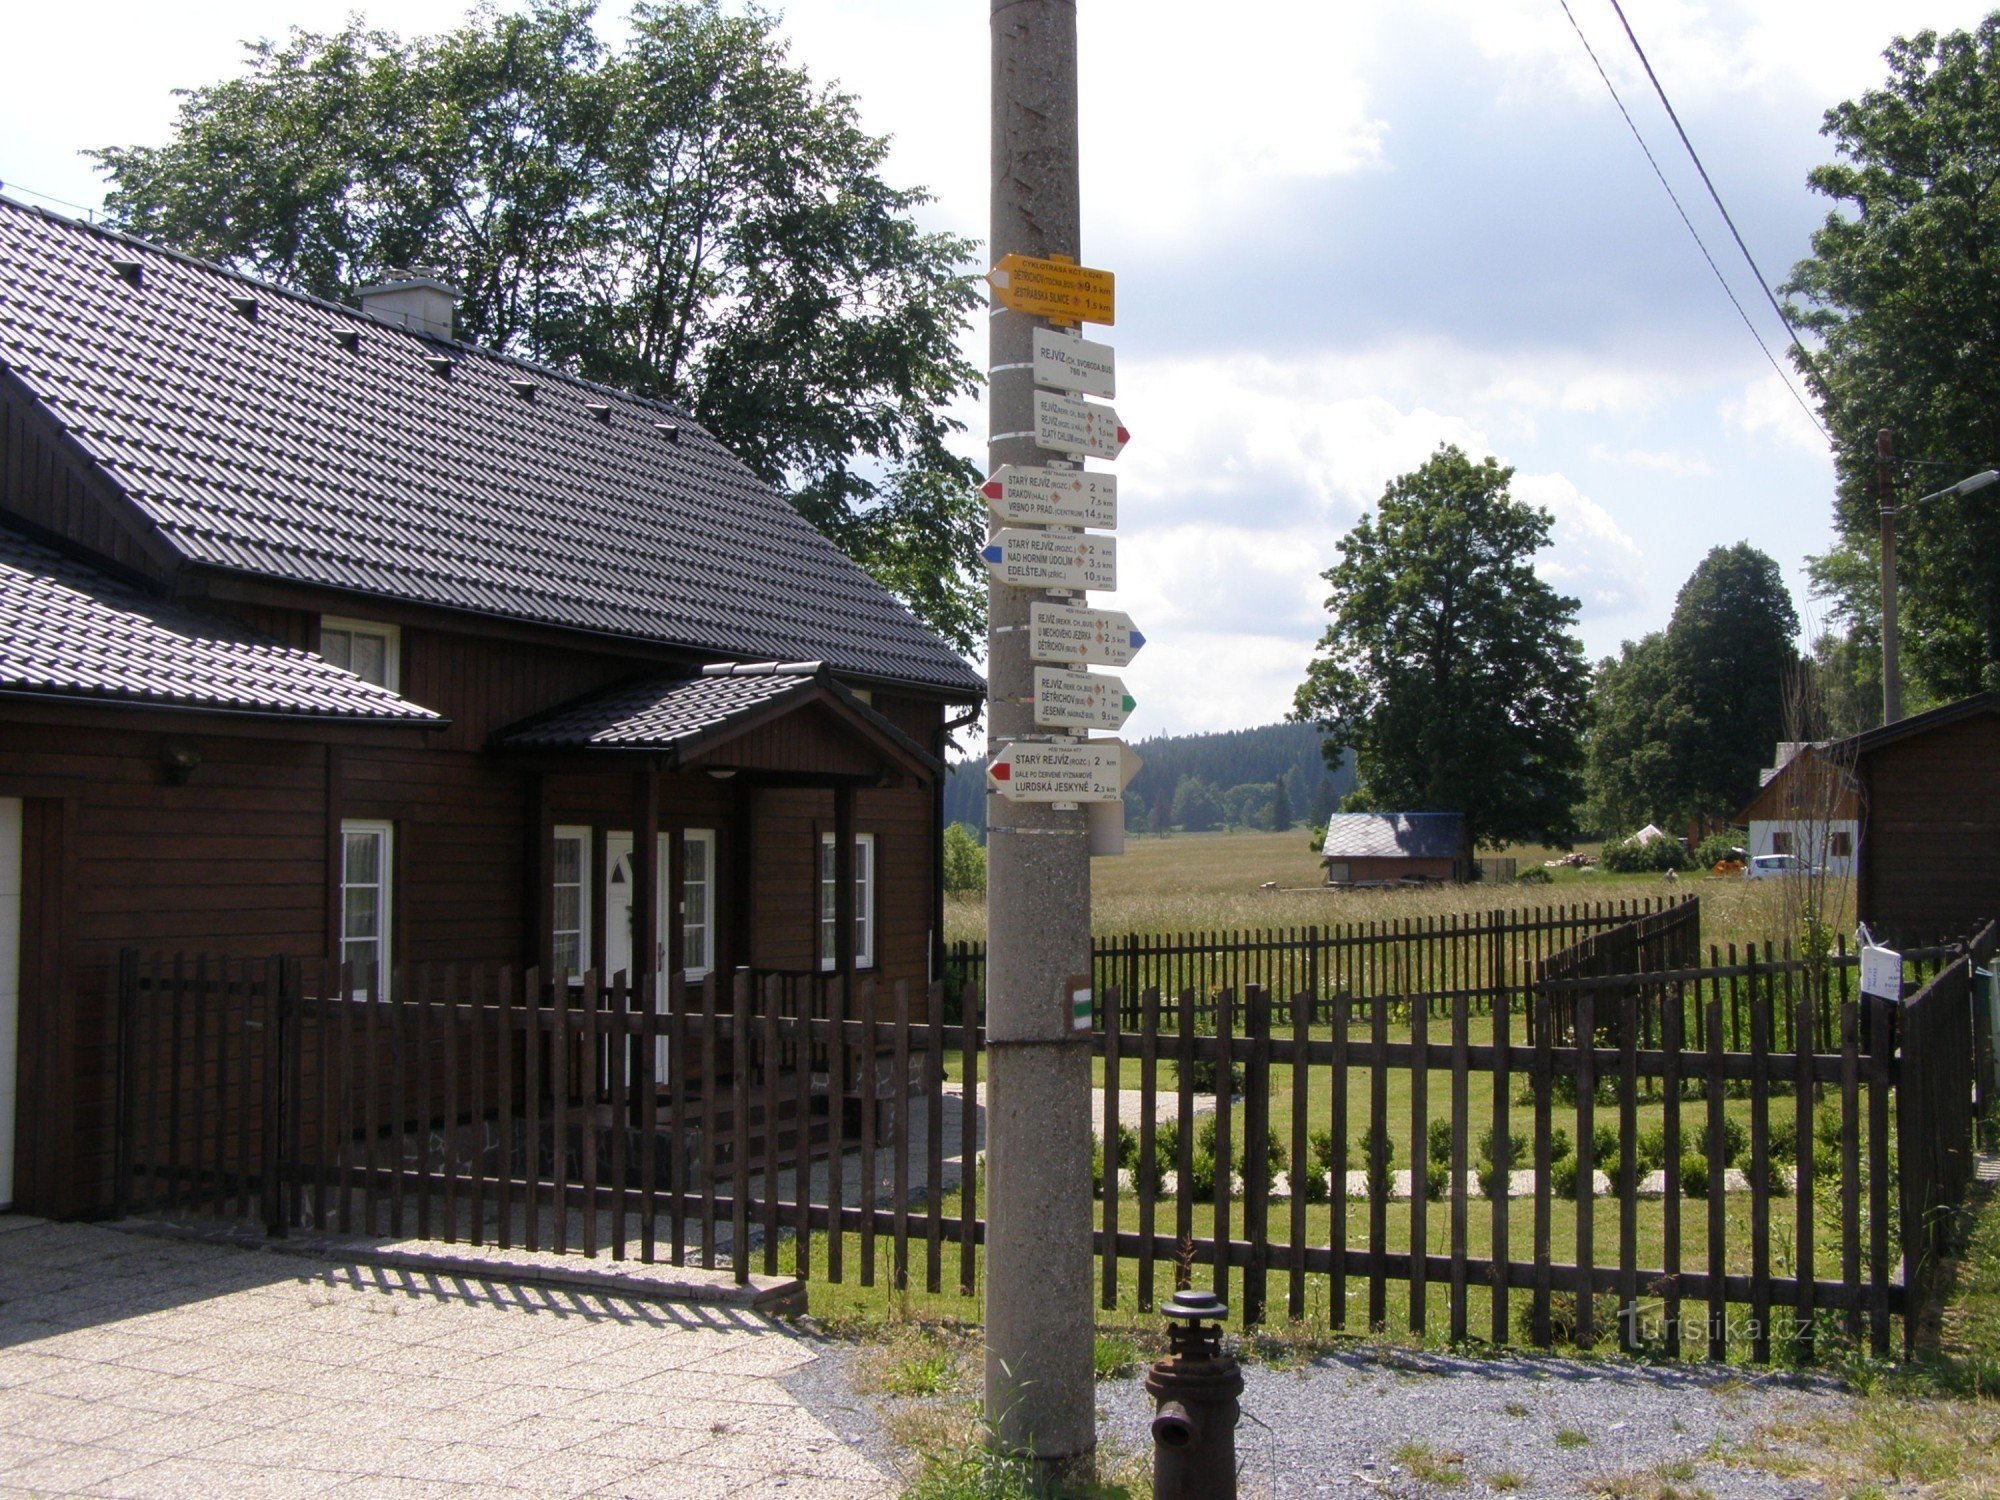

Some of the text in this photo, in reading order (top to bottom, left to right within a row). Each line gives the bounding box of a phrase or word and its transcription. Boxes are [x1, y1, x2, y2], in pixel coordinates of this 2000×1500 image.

[1022, 260, 1067, 274] CYKLOTRASA
[1099, 286, 1111, 295] km
[1099, 303, 1111, 312] km
[1040, 346, 1066, 363] REJVÍZ
[1008, 475, 1029, 486] STARÝ
[1030, 477, 1051, 488] REJVÍZ
[1090, 483, 1096, 492] 2
[1008, 488, 1032, 500] DRAKOV
[1008, 502, 1029, 513] VRBNO
[1008, 538, 1030, 549] STARÝ
[1031, 541, 1054, 552] REJVÍZ
[1089, 546, 1095, 555] 2
[1008, 552, 1021, 562] NAD
[1008, 564, 1047, 578] EDELŠTEJN
[1038, 613, 1055, 624] REJVÍZ
[1105, 620, 1109, 629] 1
[1041, 678, 1062, 690] REJVÍZ
[1102, 685, 1105, 694] 1
[1102, 698, 1106, 707] 7
[1042, 705, 1066, 717] JESENÍK
[1015, 754, 1041, 764] STARÝ
[1043, 754, 1069, 766] REJVÍZ
[1094, 756, 1101, 766] 2
[1015, 781, 1052, 792] LURDSKÁ
